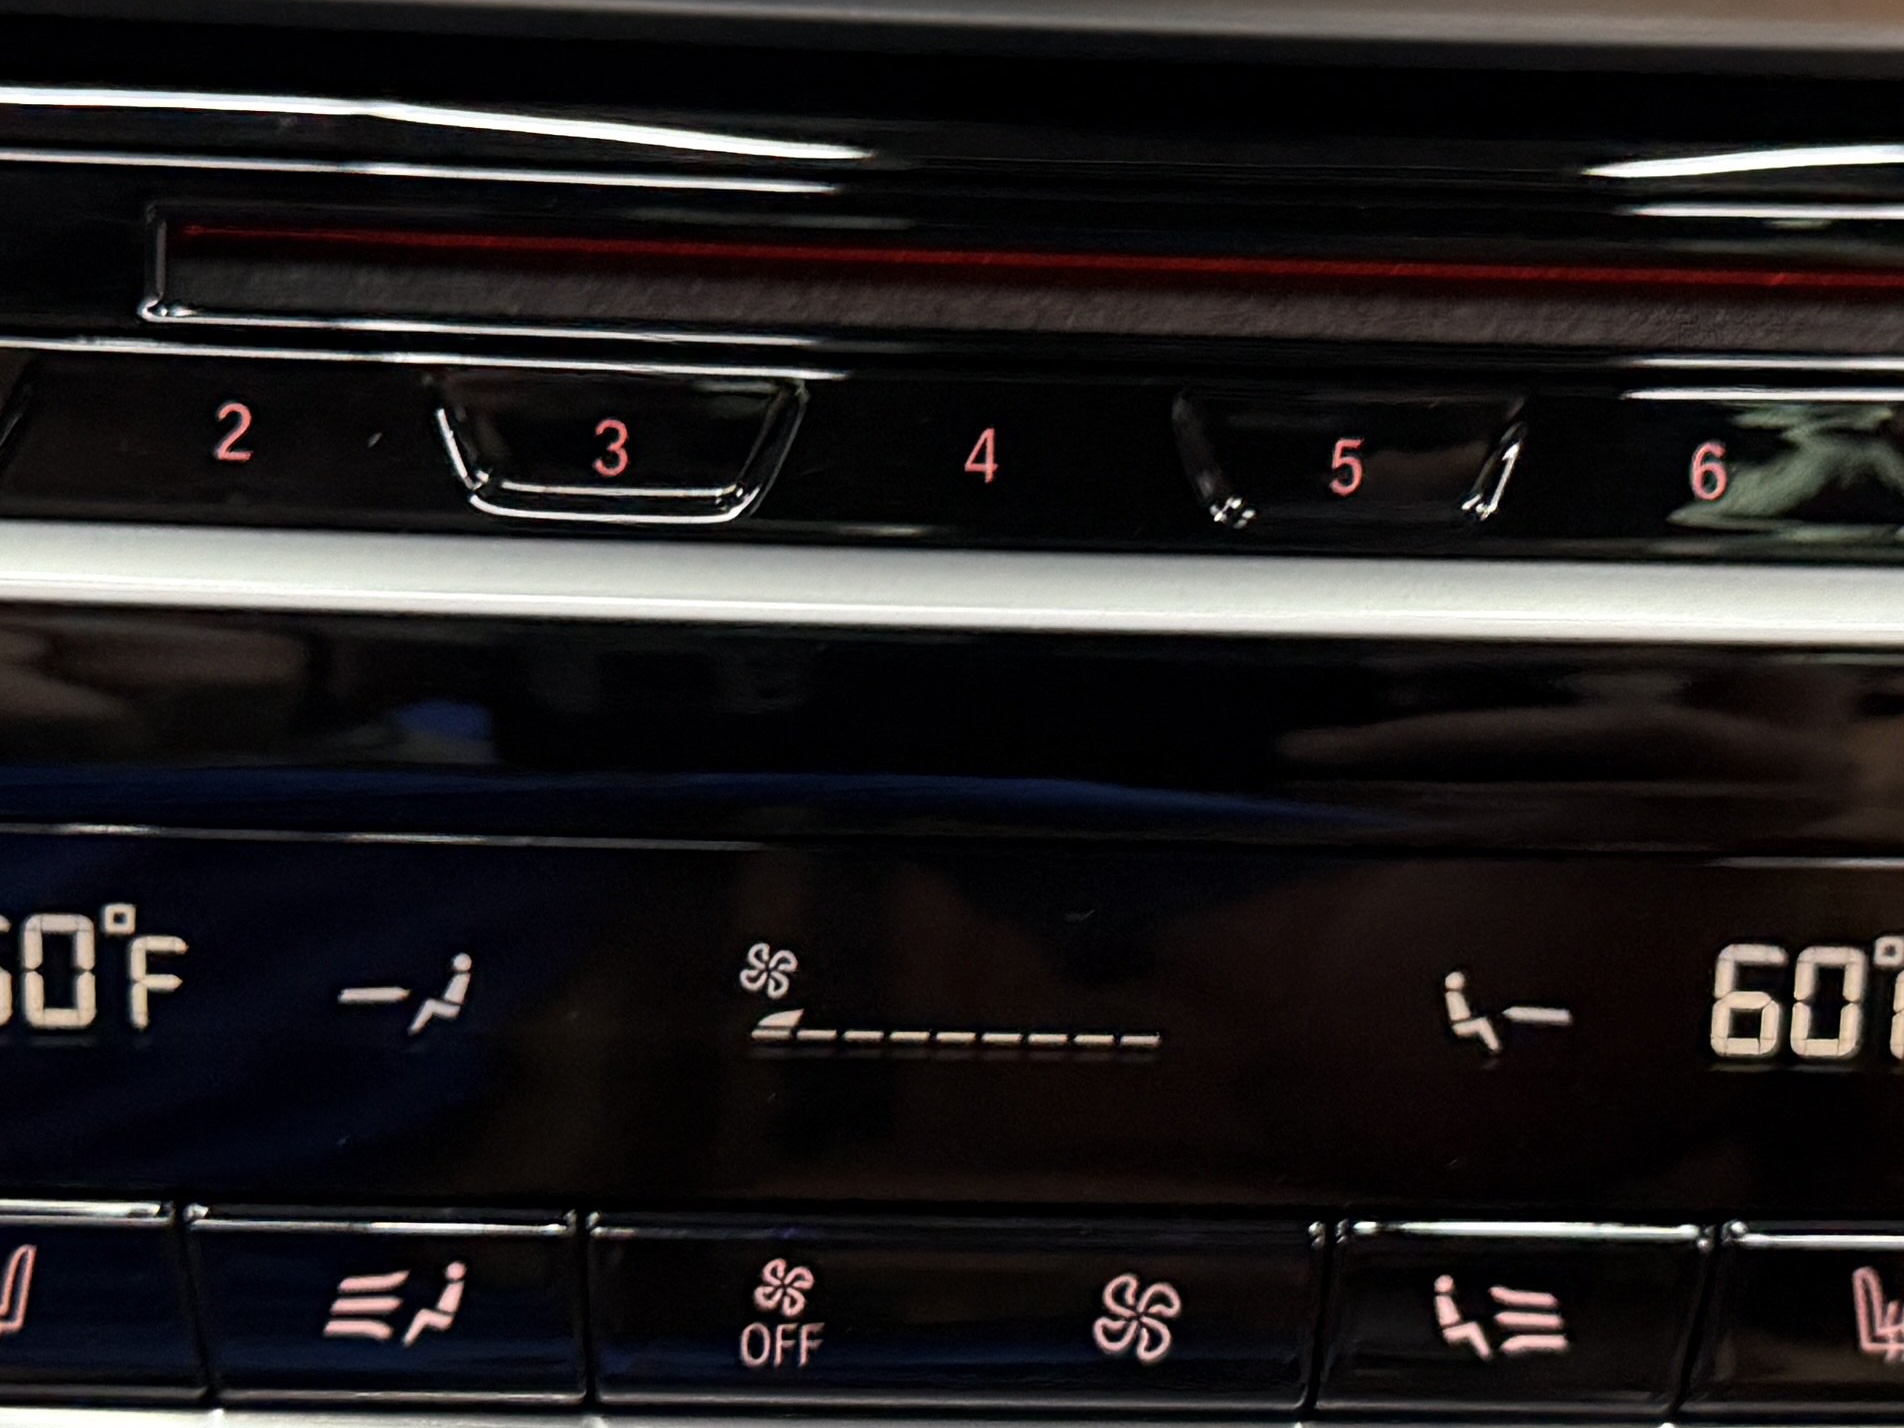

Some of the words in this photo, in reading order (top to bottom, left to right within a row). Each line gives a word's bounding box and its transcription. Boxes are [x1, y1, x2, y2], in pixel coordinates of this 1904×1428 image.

[215, 402, 253, 462] 2
[593, 419, 630, 478] 3
[963, 428, 999, 484] 4
[1330, 438, 1364, 496] 5
[1692, 443, 1728, 501] 6
[739, 1320, 823, 1369] OFF
